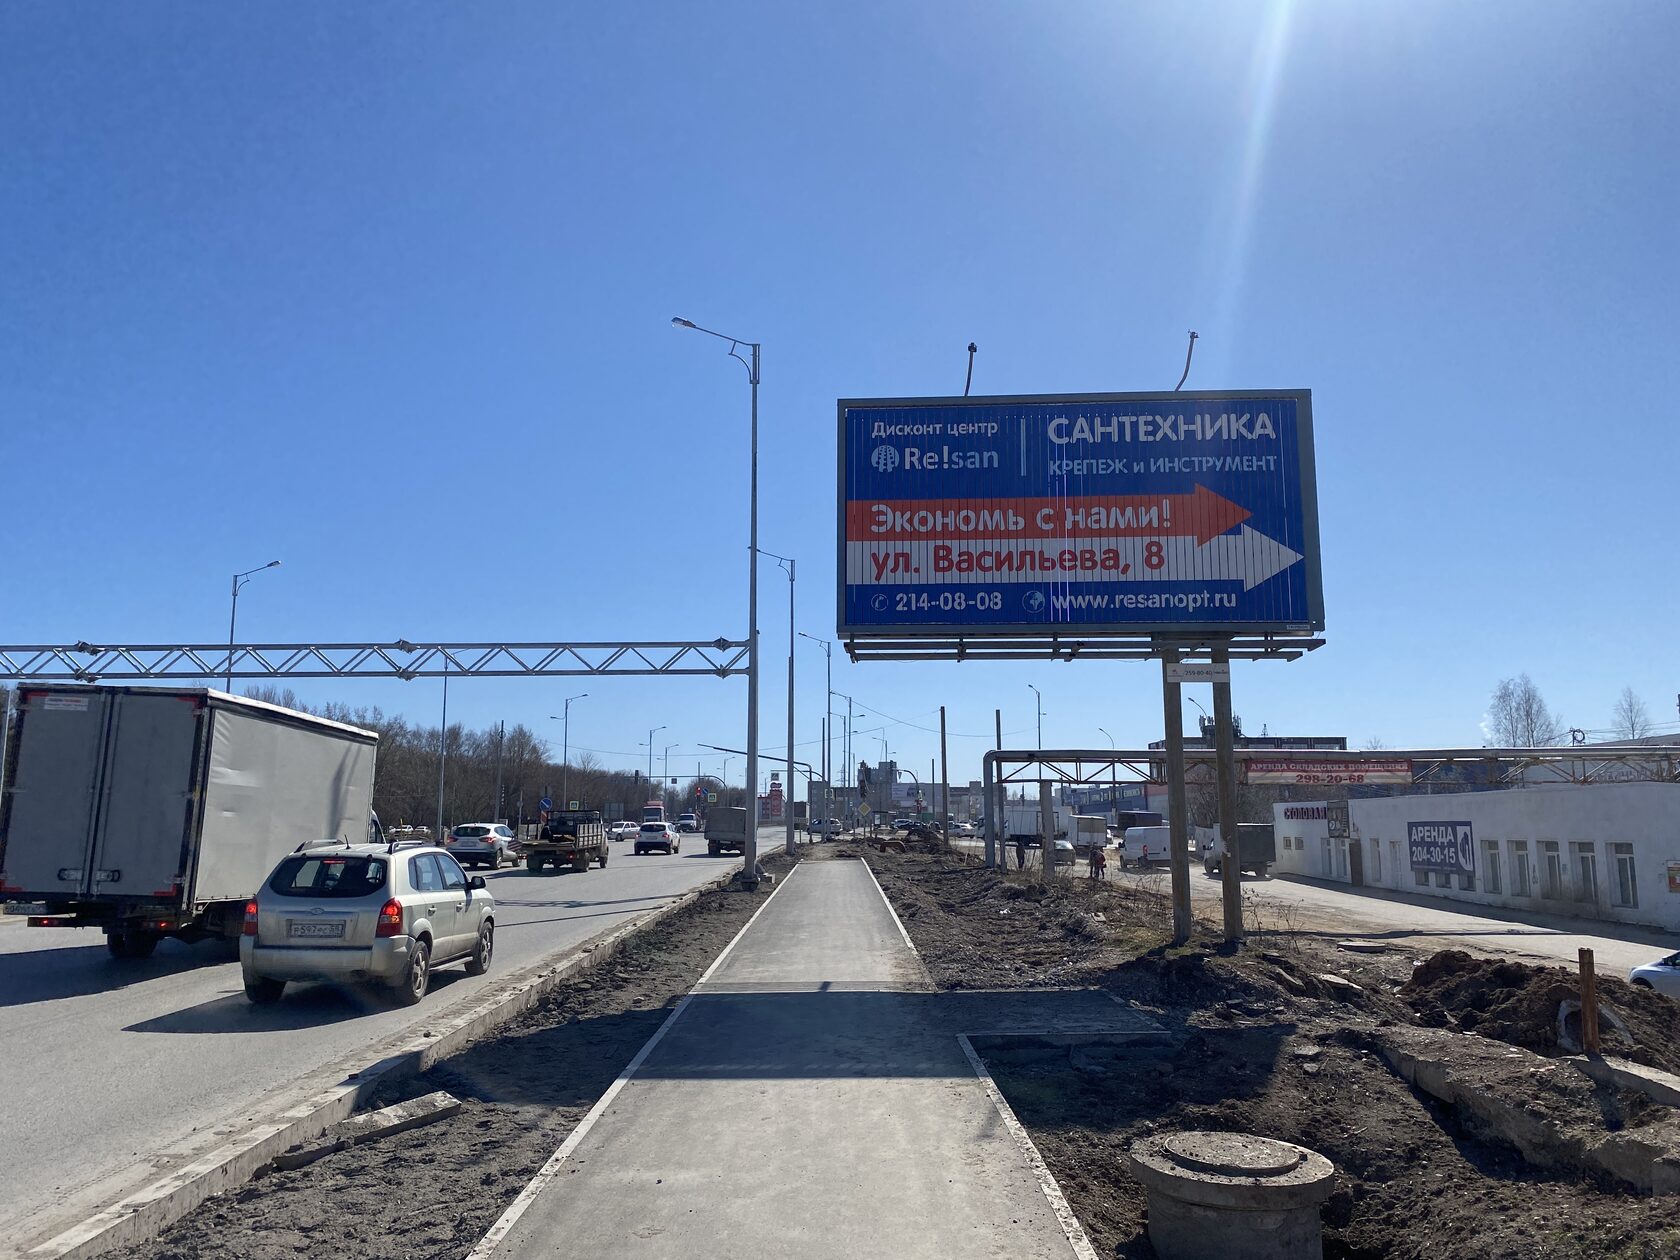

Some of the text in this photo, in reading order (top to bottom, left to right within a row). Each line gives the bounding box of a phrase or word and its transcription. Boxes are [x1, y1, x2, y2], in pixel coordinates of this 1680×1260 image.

[871, 421, 999, 439] Дисконт центр
[1048, 413, 1277, 444] САНТЕХНИКА
[904, 446, 999, 470] Re!san
[1049, 455, 1278, 476] КРЕПЕЖ и ИНСТРУМЕНТ
[871, 498, 1171, 533] Экономь с нами!
[871, 540, 1165, 582] ул. Васильева, 8
[895, 592, 1002, 611] 214-08-08
[1052, 589, 1237, 613] www.resanopt.ru
[1295, 773, 1365, 784] 298-20-68
[1411, 825, 1455, 846] АРЕНДА
[1412, 846, 1456, 864] 204-30-15
